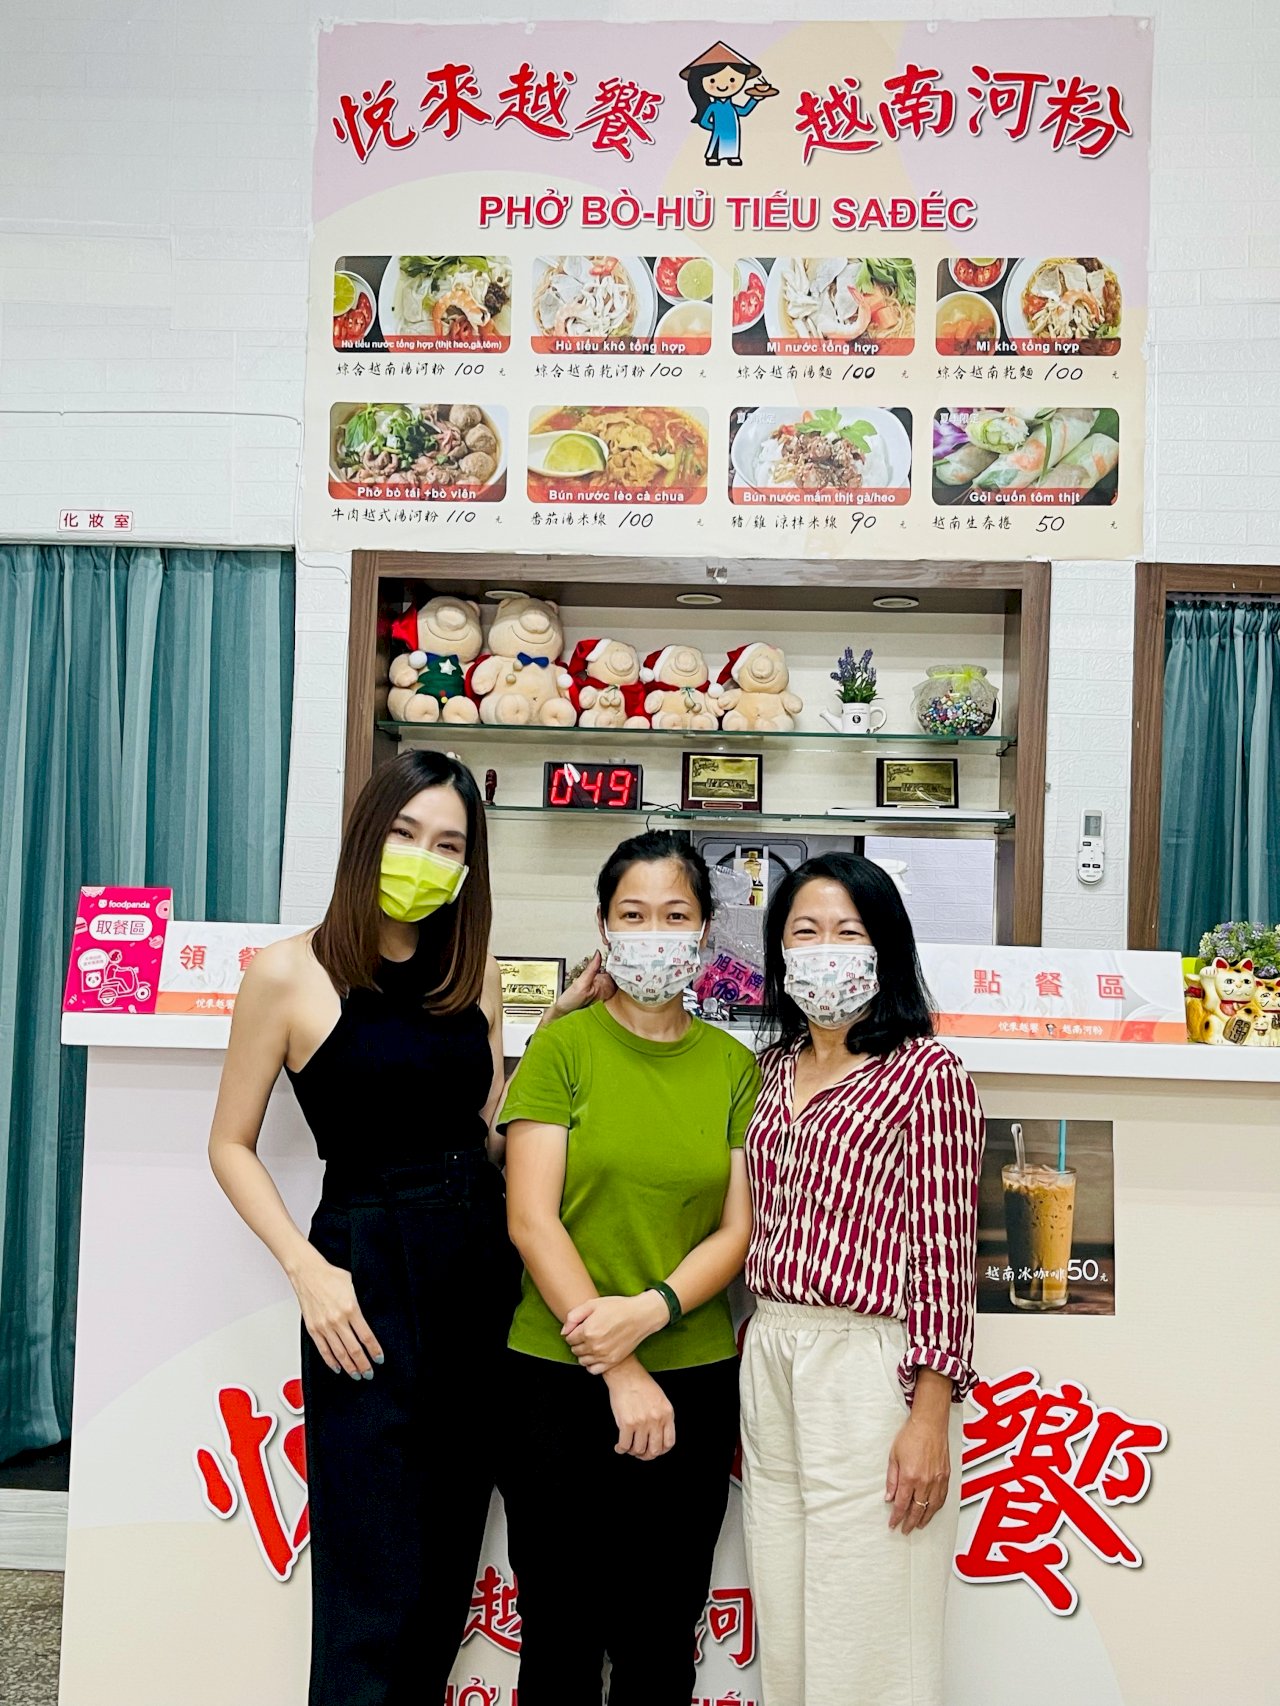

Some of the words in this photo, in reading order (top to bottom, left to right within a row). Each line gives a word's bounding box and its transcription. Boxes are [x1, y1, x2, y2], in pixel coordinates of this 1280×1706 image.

[332, 62, 664, 164] 悅來越饗
[794, 63, 1133, 166] 越南河粉
[479, 188, 569, 228] PHỞ
[581, 188, 714, 230] BÒ-HỦ
[725, 190, 820, 231] TIẾU
[832, 191, 977, 231] SAĐÉC
[603, 341, 626, 351] khô
[629, 340, 657, 354] tổng
[661, 341, 686, 354] hợp
[785, 342, 818, 352] nước
[822, 340, 850, 354] tổng
[854, 342, 880, 355] hợp
[994, 341, 1018, 352] khô
[1022, 340, 1050, 353] tổng
[1054, 342, 1080, 354] hợp
[454, 362, 484, 376] 100
[650, 362, 683, 378] 100
[842, 364, 876, 381] 100
[1044, 362, 1083, 381] 100
[357, 486, 383, 498] Phở
[386, 488, 402, 498] bò
[404, 488, 420, 498] tái
[450, 488, 477, 499] viên
[548, 489, 574, 500] Bún
[577, 490, 610, 501] nước
[614, 490, 632, 501] lèo
[654, 491, 684, 502] chua
[743, 492, 766, 502] Bún
[770, 492, 800, 502] nước
[834, 492, 854, 504] thịt
[1030, 491, 1055, 502] tôm
[1058, 492, 1081, 504] thịt
[64, 512, 130, 528] 化妝室
[446, 510, 476, 524] 110
[618, 510, 654, 528] 100
[850, 511, 878, 534] 90
[1035, 516, 1065, 532] 50
[108, 900, 150, 910] foodpanda
[96, 920, 146, 936] 取餐區
[973, 968, 1124, 999] 點餐區
